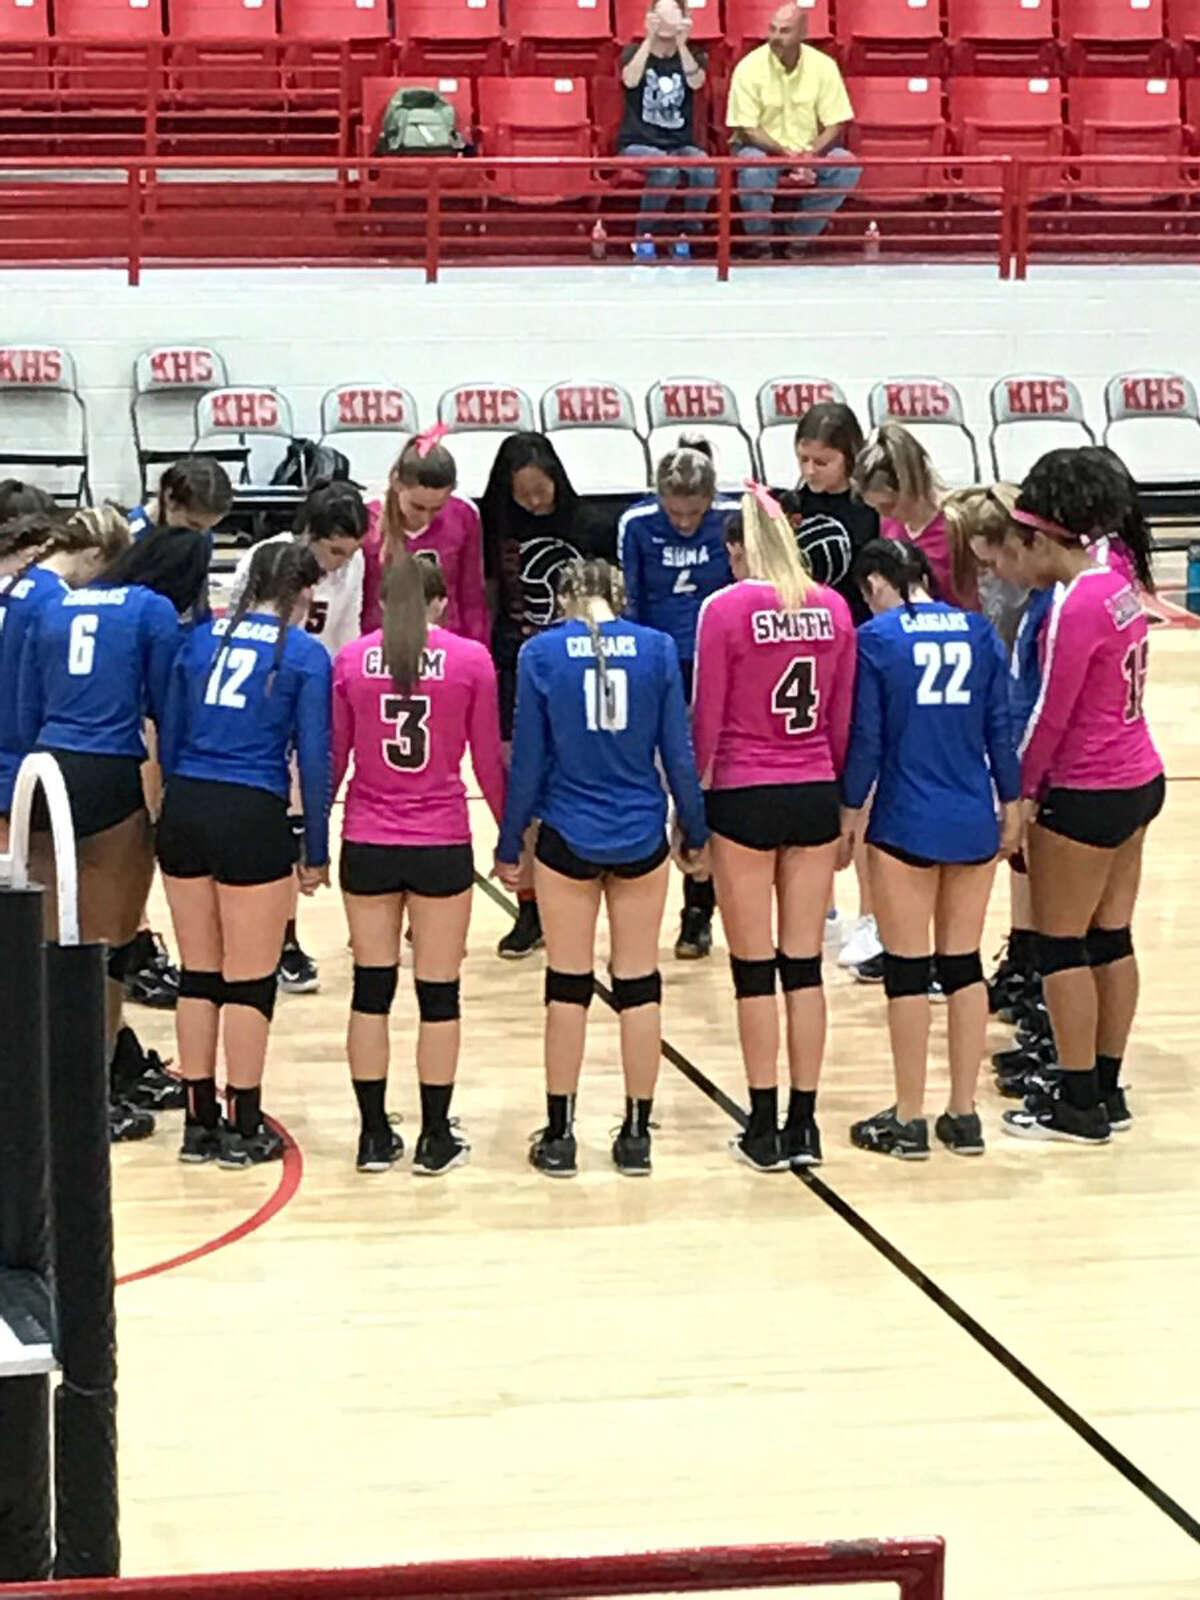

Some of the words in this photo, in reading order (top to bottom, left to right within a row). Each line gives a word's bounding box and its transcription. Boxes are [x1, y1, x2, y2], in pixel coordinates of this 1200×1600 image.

[0, 350, 62, 383] KHS
[151, 351, 213, 383] KHS
[212, 393, 279, 427] KHS
[338, 390, 404, 424] KHS
[456, 390, 520, 423] KHS
[556, 386, 620, 421] KHS
[661, 384, 727, 417] KHS
[884, 384, 950, 416] KHS
[1005, 380, 1069, 413] KHS
[1122, 377, 1185, 410] KHS
[305, 600, 329, 634] 5
[752, 607, 834, 643] SMITH
[68, 613, 99, 675] 6
[204, 646, 258, 709] 12
[913, 641, 972, 705] 22
[771, 656, 820, 734] 4
[380, 693, 431, 773] 3
